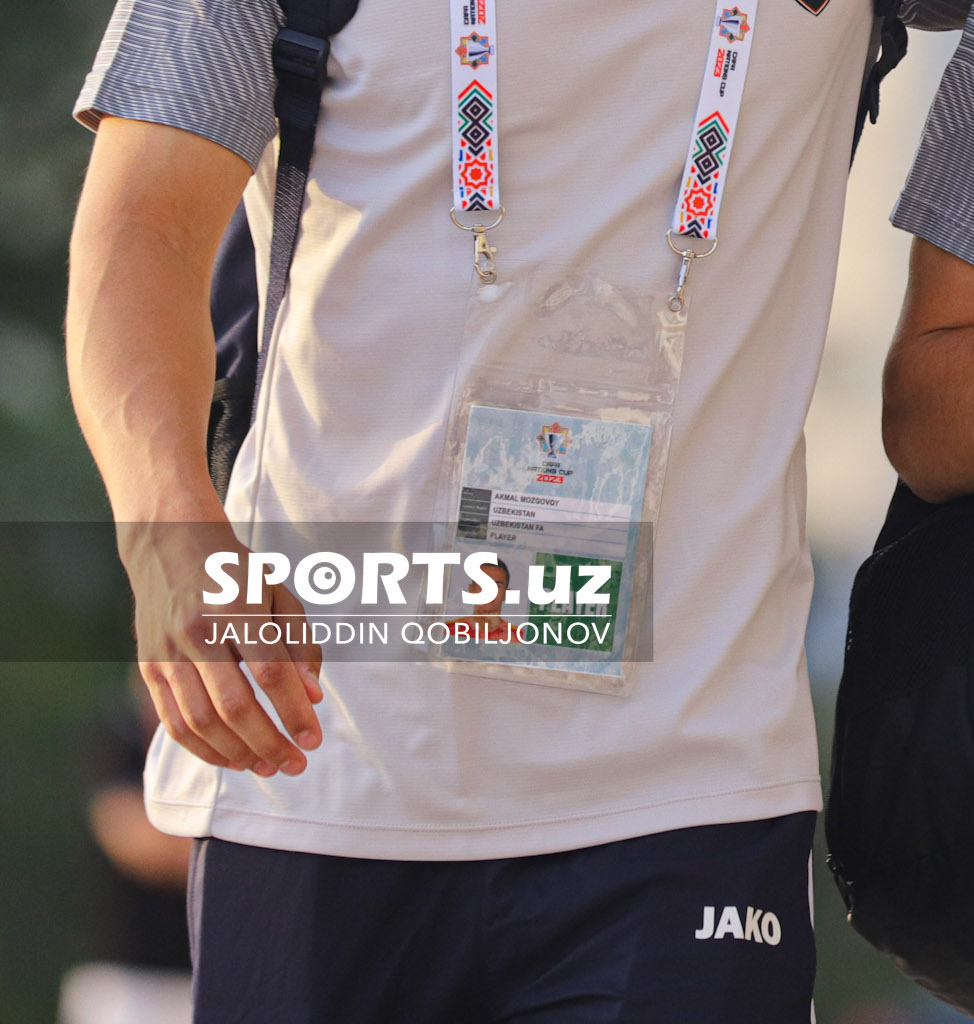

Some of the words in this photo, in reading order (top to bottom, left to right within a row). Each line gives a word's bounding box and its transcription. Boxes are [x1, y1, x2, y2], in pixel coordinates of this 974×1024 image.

[713, 48, 726, 77] 2023
[536, 474, 564, 484] 2023
[494, 493, 518, 503] AKMAL
[520, 496, 560, 507] MOZGOVOY
[493, 507, 536, 518] UZBEKISTAN
[491, 520, 534, 532] UZBEKISTAN
[535, 524, 544, 532] FA
[489, 532, 517, 542] PLAYER
[695, 906, 781, 946] JAKO
